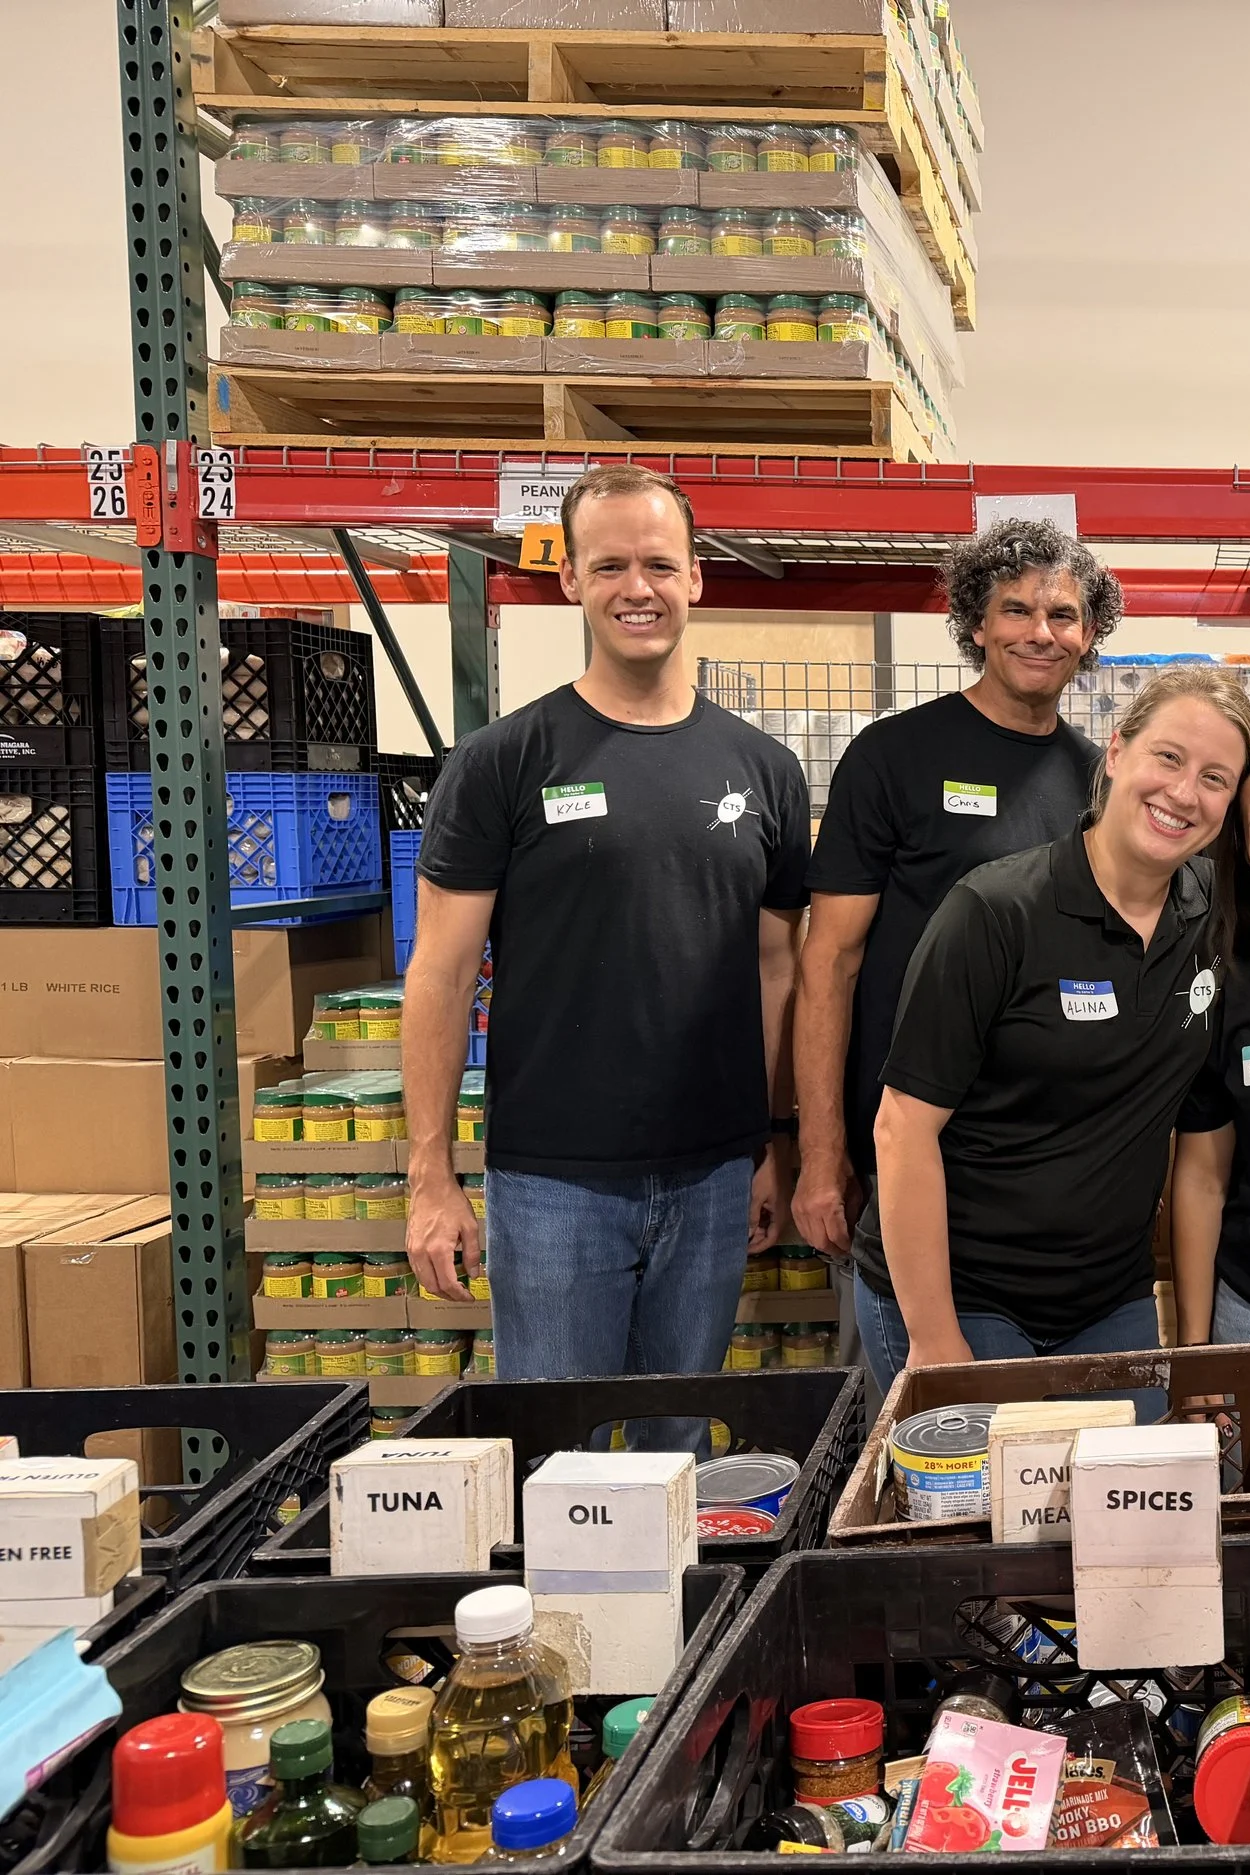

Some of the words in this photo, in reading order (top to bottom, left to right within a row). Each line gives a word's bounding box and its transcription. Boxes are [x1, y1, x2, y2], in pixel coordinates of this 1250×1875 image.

[90, 450, 123, 481] 25
[201, 452, 233, 482] 23
[521, 485, 570, 497] PEANU
[93, 486, 125, 516] 26
[202, 487, 233, 516] 24
[523, 505, 559, 516] BUTT
[530, 539, 558, 566] 1
[560, 785, 586, 794] HELLO
[556, 801, 592, 816] KYLE
[723, 802, 741, 813] CTS
[948, 795, 980, 808] Chris
[11, 982, 28, 992] LB
[46, 983, 86, 992] WHITE
[90, 984, 120, 993] RICE
[1073, 983, 1095, 991] HELLO
[1194, 986, 1212, 996] CTS
[1067, 1001, 1107, 1015] ALINA
[23, 1472, 100, 1480] GLUTEN
[367, 1490, 444, 1514] TUNA
[1106, 1489, 1194, 1513] SPICES
[568, 1504, 613, 1526] OIL
[1021, 1507, 1071, 1526] MEA
[30, 1546, 72, 1560] FREE
[984, 1768, 1000, 1809] strawberry
[1095, 1789, 1108, 1800] MIX
[1058, 1806, 1090, 1826] MOKY
[1085, 1814, 1122, 1834] BBQ
